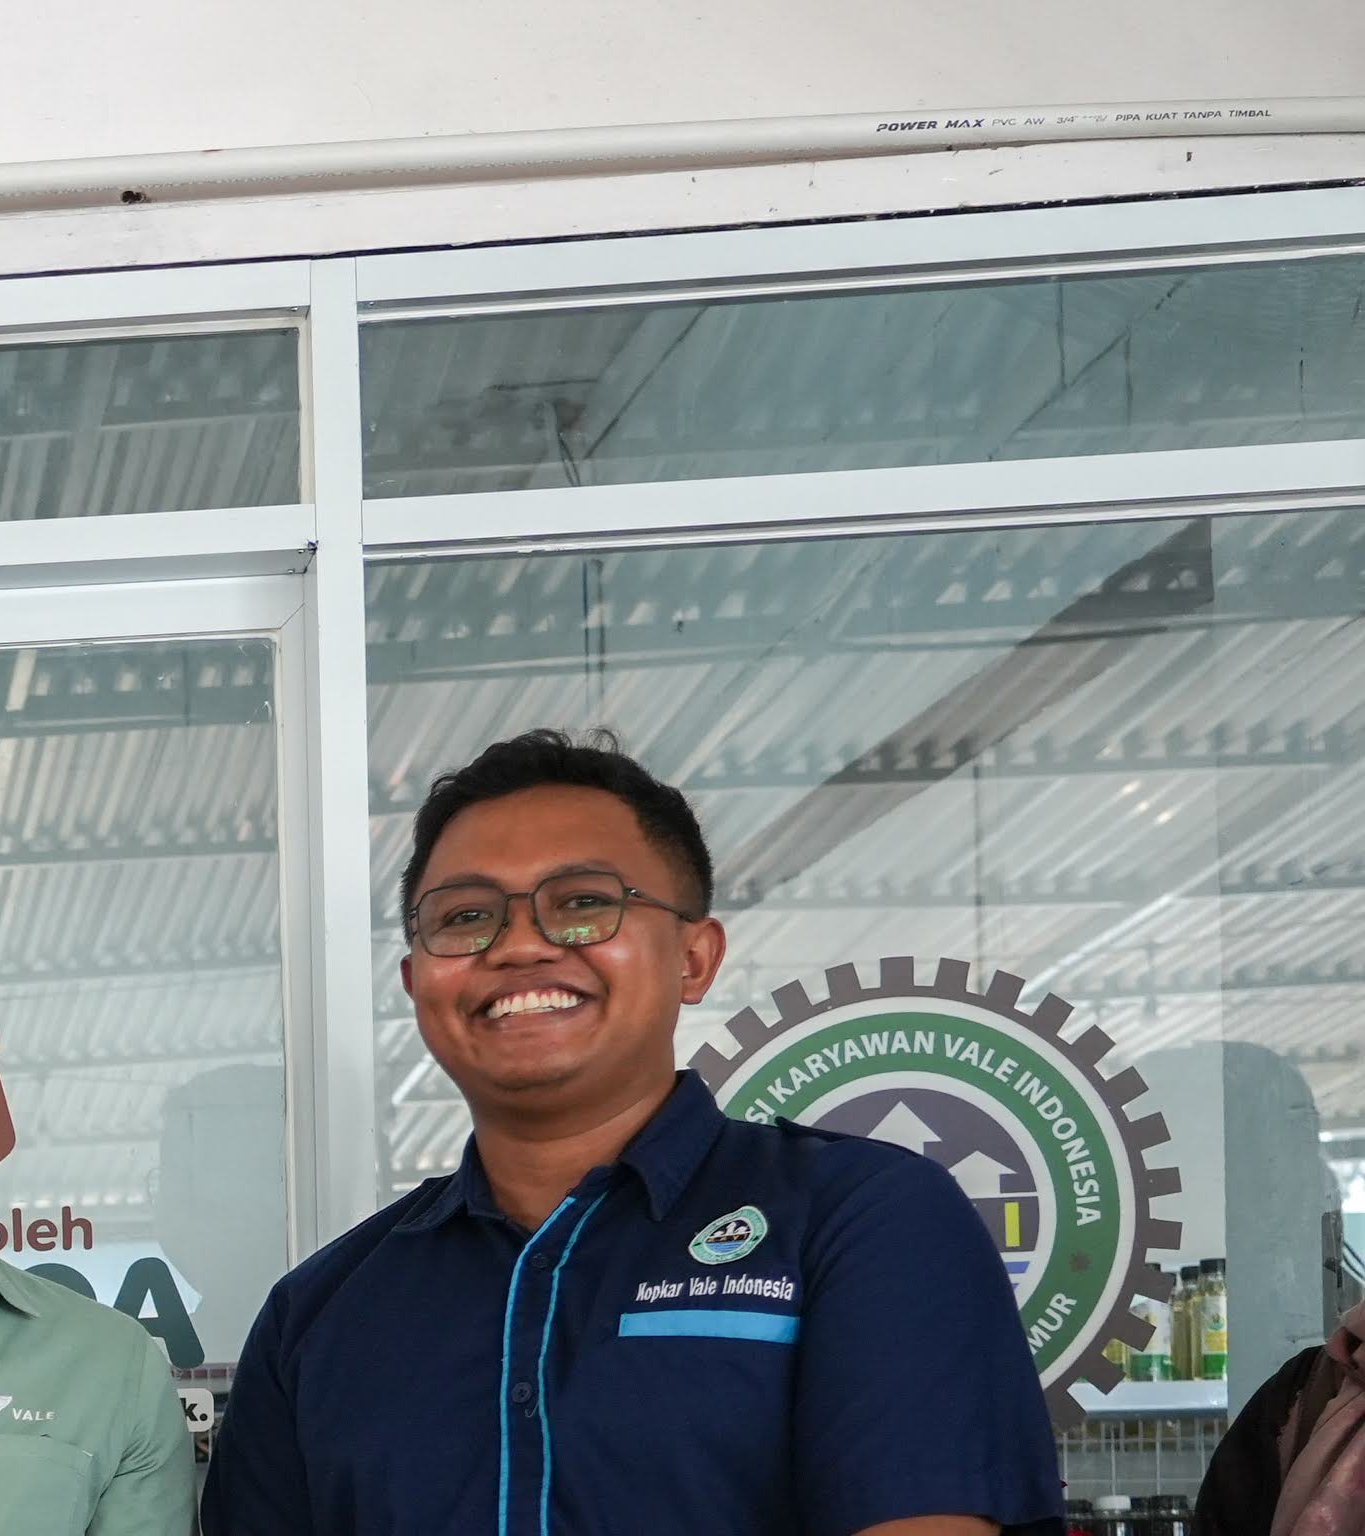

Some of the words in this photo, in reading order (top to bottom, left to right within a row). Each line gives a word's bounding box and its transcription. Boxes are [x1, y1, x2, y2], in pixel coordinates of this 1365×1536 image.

[876, 121, 937, 132] POWER
[945, 119, 985, 129] MAX
[992, 118, 1016, 126] PVC
[1145, 112, 1178, 120] KUAT
[1183, 110, 1222, 119] TANPA
[1228, 109, 1272, 117] TIMBAL
[767, 1030, 935, 1104] KARYAWAN
[944, 1033, 1019, 1083] VALE
[1013, 1070, 1102, 1226] INDONESIA
[636, 1279, 684, 1303] Kopkar
[689, 1275, 717, 1296] Vale
[722, 1274, 794, 1301] Indonesia
[12, 1408, 55, 1421] VALE
